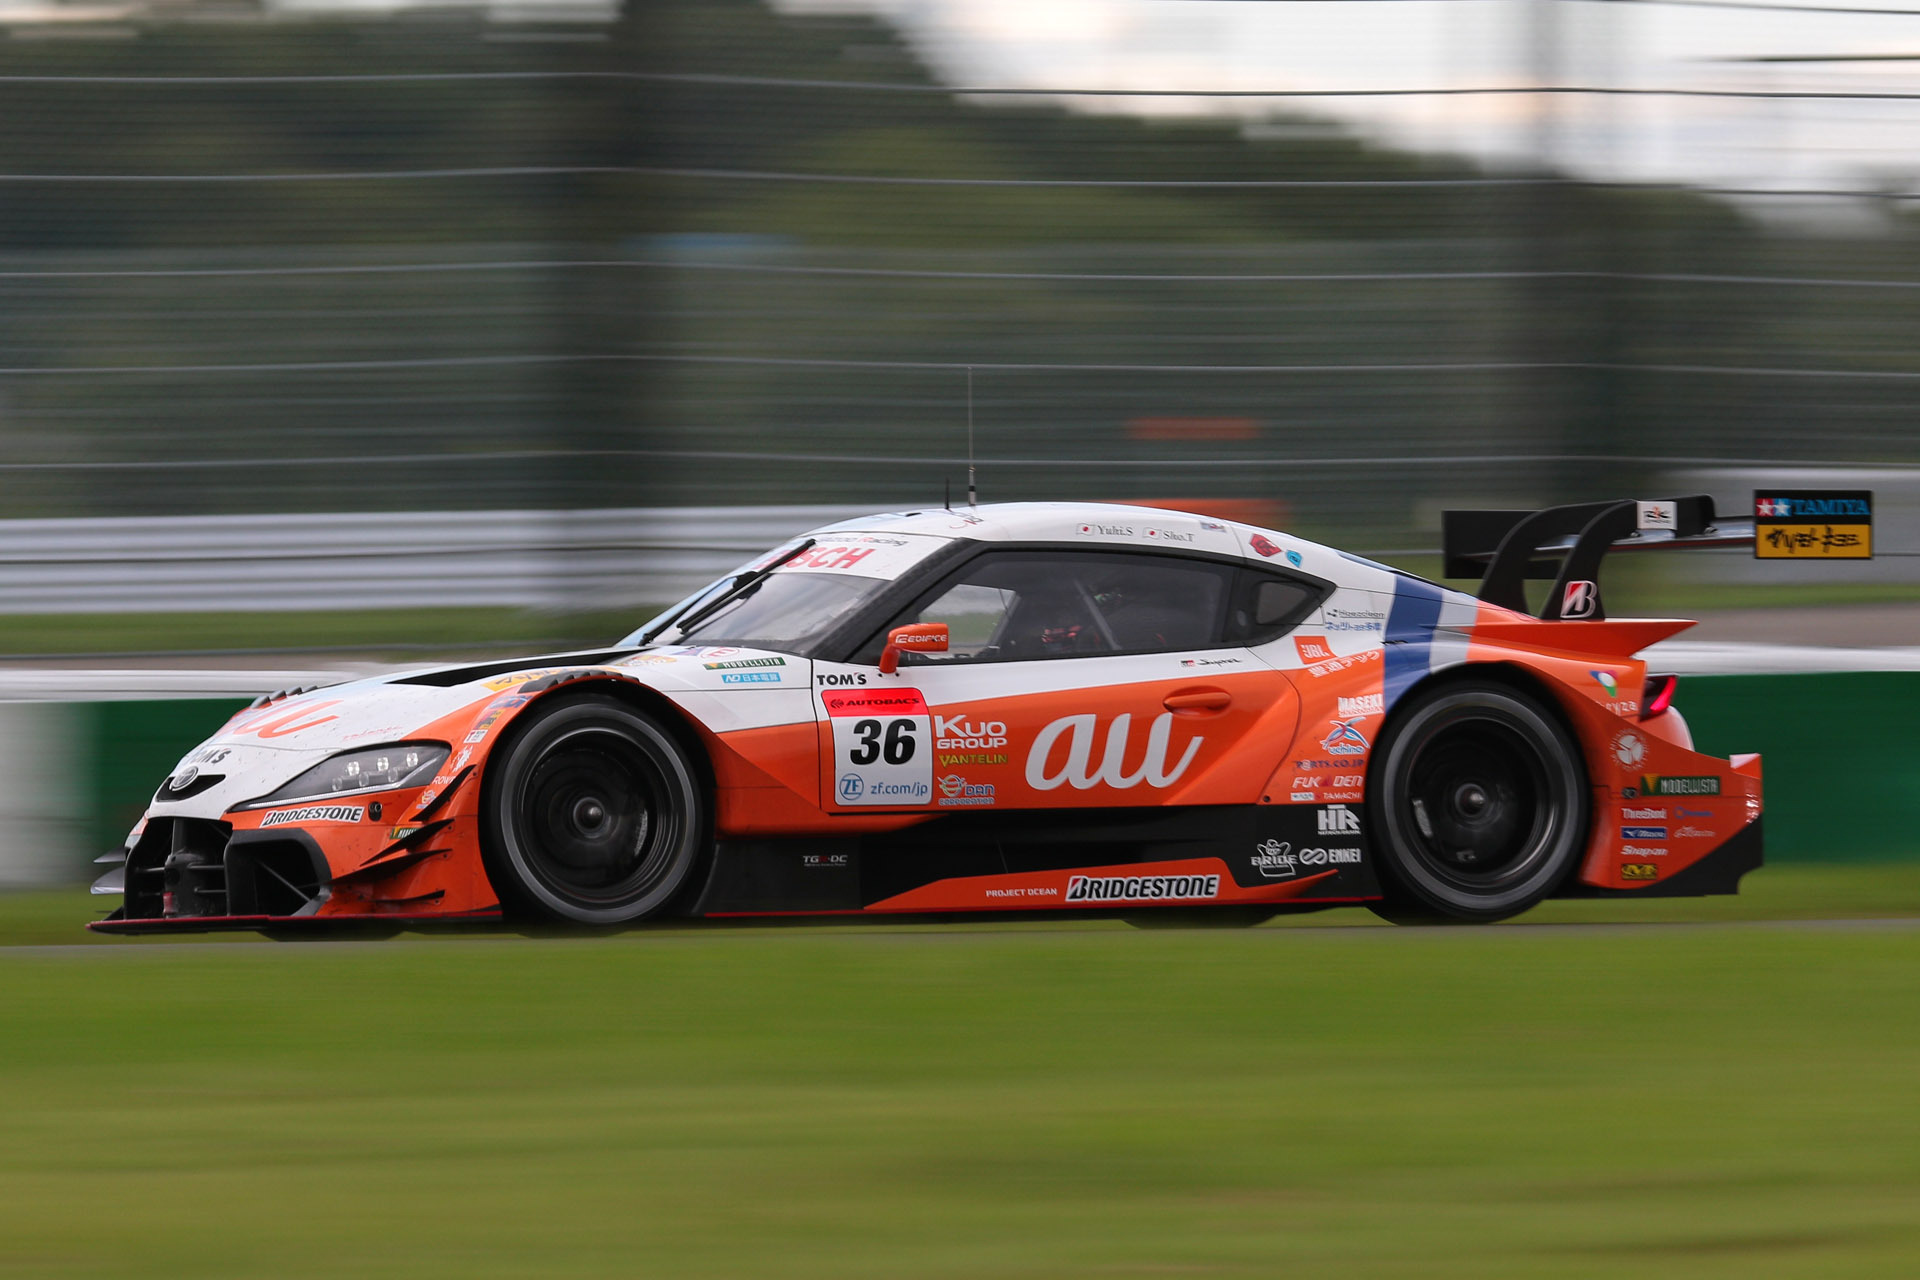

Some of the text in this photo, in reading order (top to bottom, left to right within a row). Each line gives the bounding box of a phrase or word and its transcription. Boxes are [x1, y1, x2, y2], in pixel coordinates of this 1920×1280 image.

[1791, 499, 1872, 515] TAMIYA
[908, 634, 947, 643] EDIFICE
[1300, 644, 1331, 658] JBL
[722, 657, 781, 669] MODELLISTA
[816, 672, 867, 686] TOM'S
[846, 698, 920, 706] AUTOBACS
[1337, 694, 1384, 711] MASEKI
[850, 718, 917, 766] 36
[936, 738, 1008, 749] GROUP
[1025, 712, 1205, 790] au
[938, 753, 1008, 768] VANTELIN
[870, 781, 928, 797] zf.com/jp
[1661, 778, 1719, 794] MODELLISTA
[938, 797, 995, 806] CORPORATION
[261, 807, 364, 827] BRIDGESTONE
[1250, 855, 1298, 866] BRIDE
[1328, 848, 1361, 863] ENKEI
[986, 888, 1058, 898] PROJECT OCEAN
[1067, 876, 1219, 900] BRIDGESTONE
